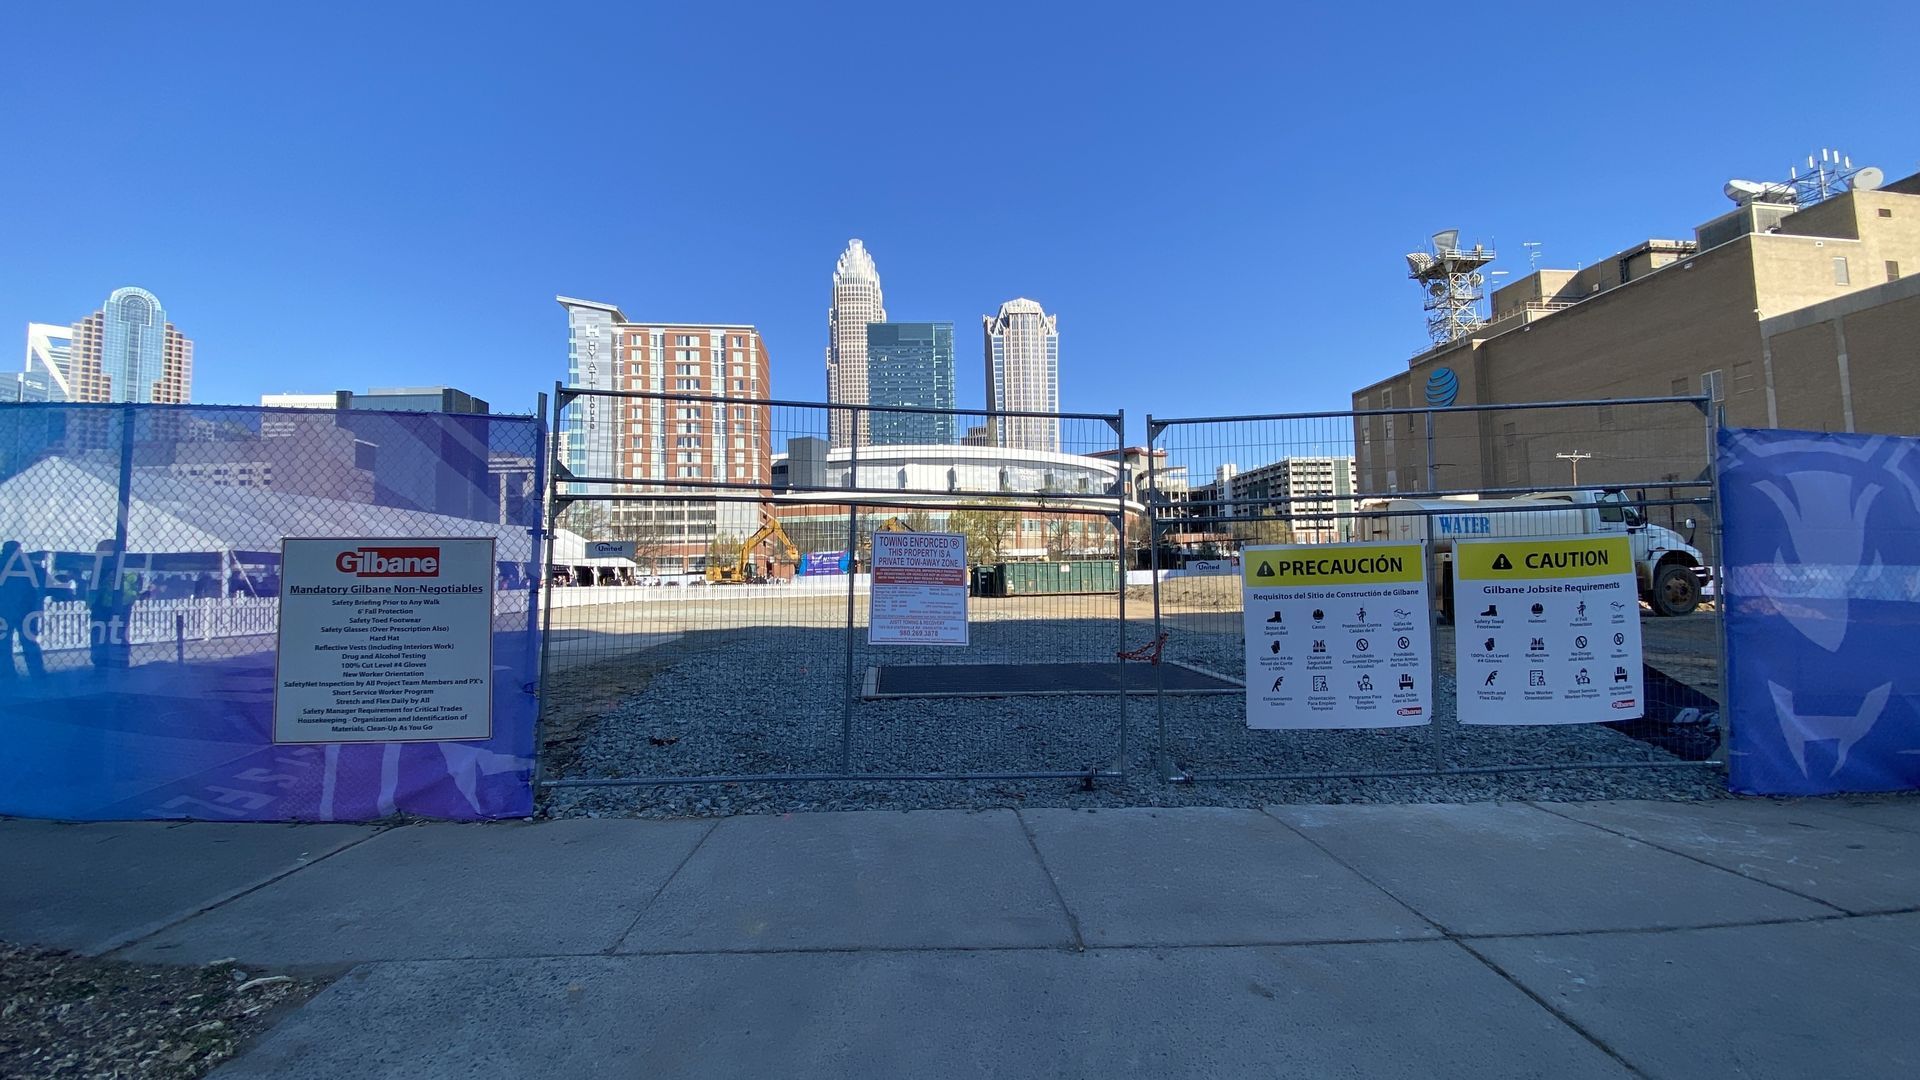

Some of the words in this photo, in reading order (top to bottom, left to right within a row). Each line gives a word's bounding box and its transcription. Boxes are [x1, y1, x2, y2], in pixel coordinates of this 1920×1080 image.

[588, 341, 597, 390] HYATT
[1439, 516, 1490, 534] WATER
[880, 537, 908, 547] TOWING
[910, 537, 948, 548] ENFORCED
[889, 548, 903, 556] THIS
[904, 548, 938, 558] PROPERTY
[939, 550, 945, 558] IS
[336, 551, 438, 574] Gilbane
[879, 557, 905, 566] PRIVATE
[906, 558, 940, 567] TOW-AWAY
[1525, 550, 1608, 569] CAUTION
[1279, 555, 1402, 576] PRECAUCIÓN
[290, 585, 349, 595] Mandatory
[350, 585, 392, 594] Gilbane
[394, 584, 483, 595] Non-Negotiables
[1483, 585, 1525, 595] Gilbane
[1526, 584, 1563, 594] Jobsite
[1565, 582, 1620, 594] Requirements
[1253, 593, 1293, 602] Requisitos
[354, 599, 381, 607] Briefing
[349, 617, 371, 625] Safety
[321, 626, 342, 634] Safety
[342, 653, 359, 661] Drug
[404, 688, 434, 696] Program
[303, 708, 325, 716] Safety
[297, 717, 347, 725] Housekeeping
[352, 716, 397, 724] Organization
